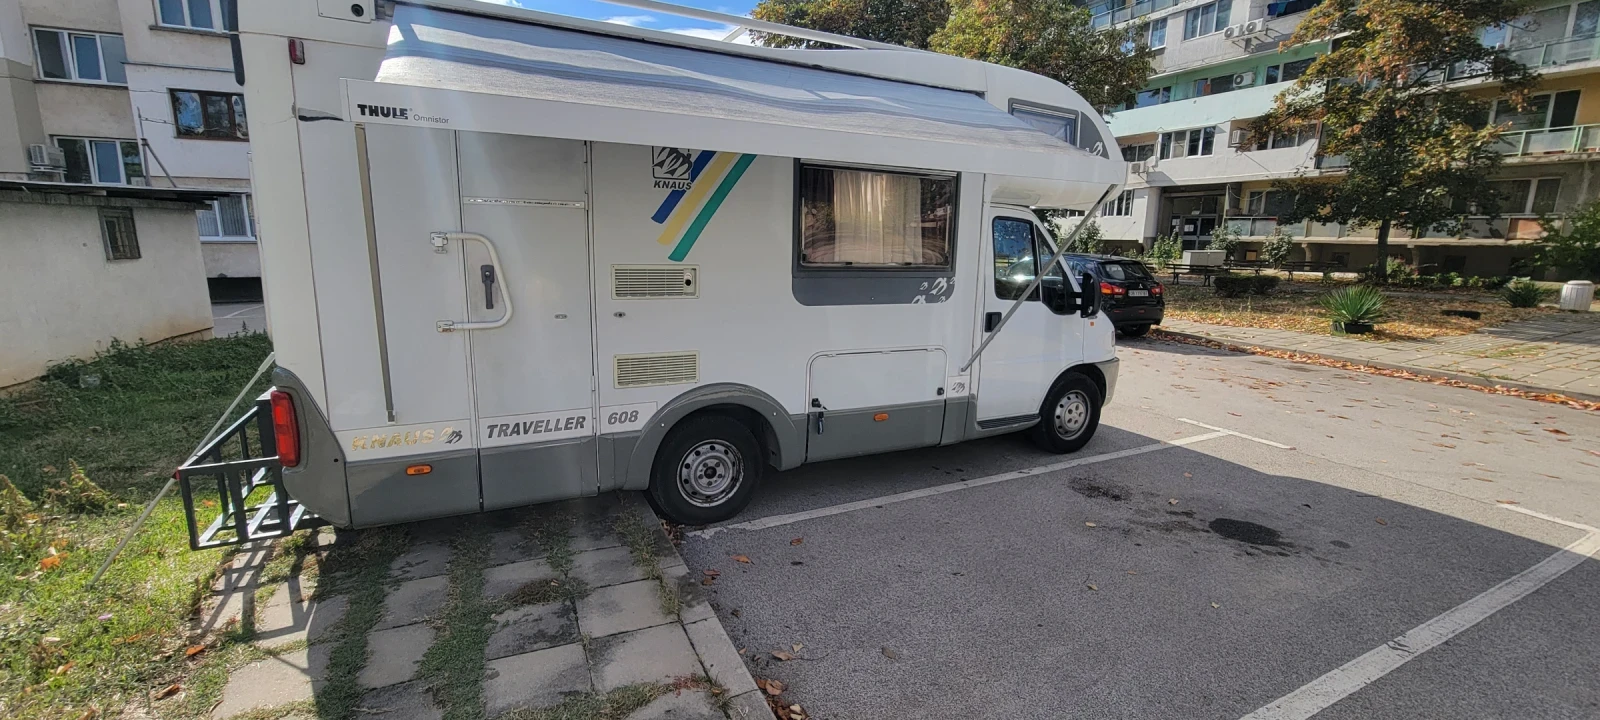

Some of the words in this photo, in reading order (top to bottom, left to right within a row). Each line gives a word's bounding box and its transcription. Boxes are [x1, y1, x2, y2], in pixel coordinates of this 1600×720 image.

[357, 103, 409, 120] THULE
[413, 114, 450, 124] Omnistor
[653, 180, 692, 190] KNAUS
[487, 415, 586, 439] TRAVELLER
[607, 409, 640, 425] 608
[351, 428, 435, 451] KNAUS
